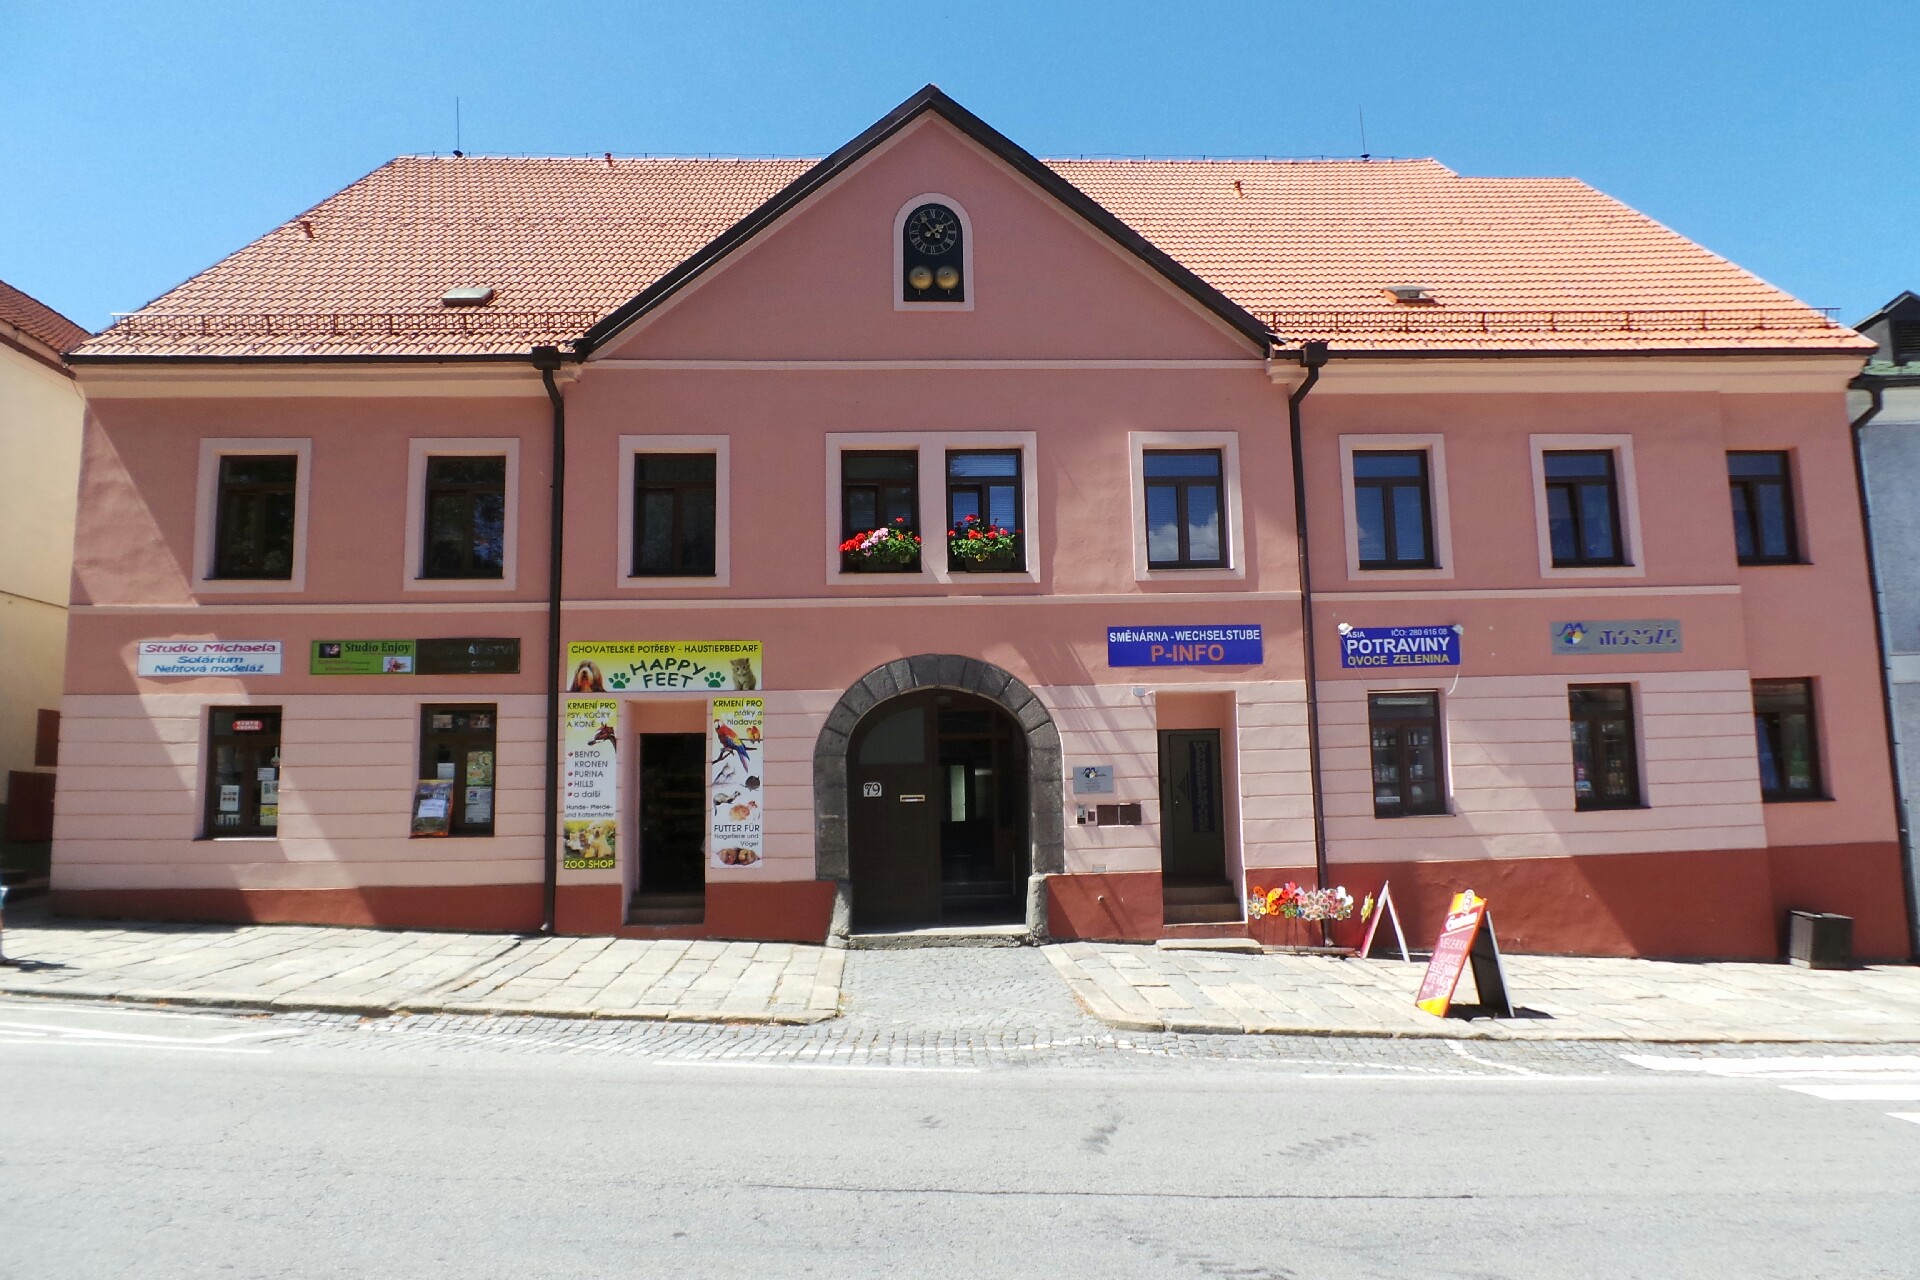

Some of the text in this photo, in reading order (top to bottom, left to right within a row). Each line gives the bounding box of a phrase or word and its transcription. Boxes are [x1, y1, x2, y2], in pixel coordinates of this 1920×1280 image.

[1109, 629, 1169, 642] SMĚNÁRNA
[1174, 630, 1260, 641] WECHSELSTUBE
[144, 643, 276, 653] Studio Michaela
[344, 642, 378, 652] Studio
[381, 642, 410, 653] Enjoy
[571, 644, 635, 654] CHOVATELSKÉ
[637, 644, 676, 653] POTŘEBY
[684, 644, 759, 653] HAUSTIERBEDARF
[1346, 637, 1450, 654] POTRAVINY
[1151, 644, 1225, 662] P-INFO
[178, 656, 244, 664] Solárium
[1347, 654, 1450, 666] OVOCE ZELENINA
[154, 664, 207, 673] Nehtová
[630, 657, 706, 676] HAPPY
[643, 672, 693, 688] FEET
[567, 700, 598, 709] KRMENÍ
[714, 698, 744, 707] KRMENÍ
[574, 780, 594, 788] HILLS
[864, 783, 880, 796] 79
[714, 823, 760, 832] FUTTER FÜR
[564, 860, 614, 869] ZOO SHOP
